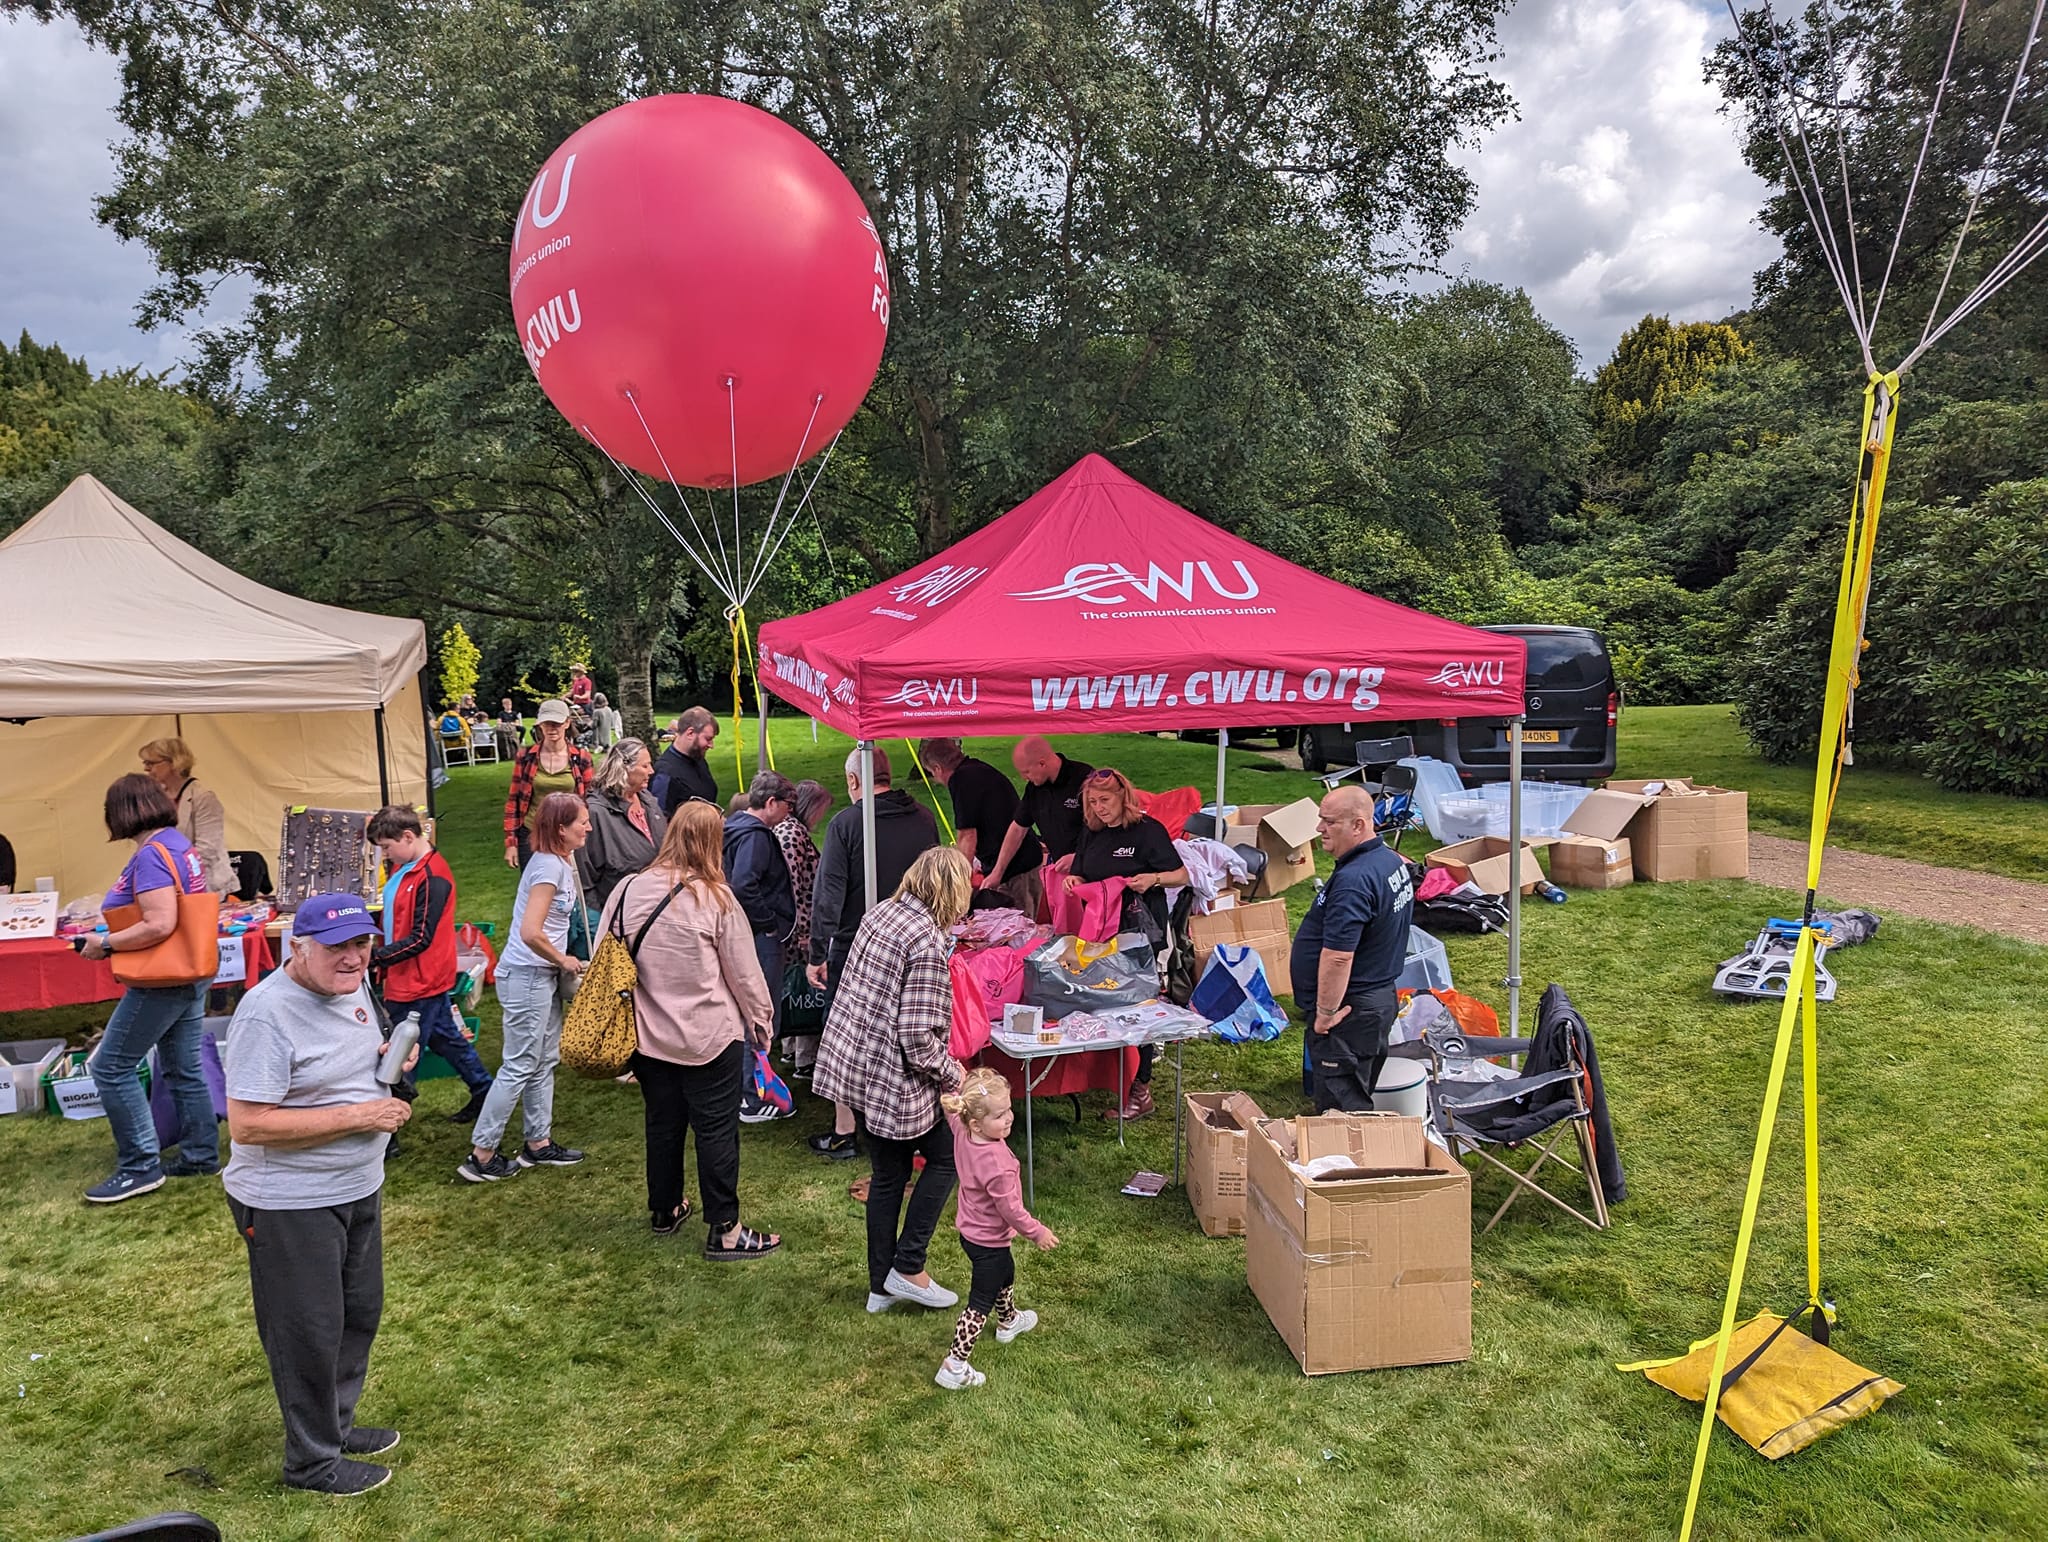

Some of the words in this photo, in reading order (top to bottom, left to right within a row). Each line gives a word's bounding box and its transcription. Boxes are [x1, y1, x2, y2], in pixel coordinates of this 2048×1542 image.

[538, 235, 571, 261] union
[895, 565, 989, 608] CWU
[1064, 560, 1259, 605] CWU
[1080, 611, 1109, 620] The
[1111, 607, 1233, 619] communications
[1234, 605, 1277, 615] union
[1440, 660, 1504, 687] CWU
[901, 677, 977, 707] CWU
[1031, 667, 1386, 711] www.cwu.org
[914, 709, 962, 717] communications
[962, 708, 979, 716] union
[789, 992, 825, 1009] M&S
